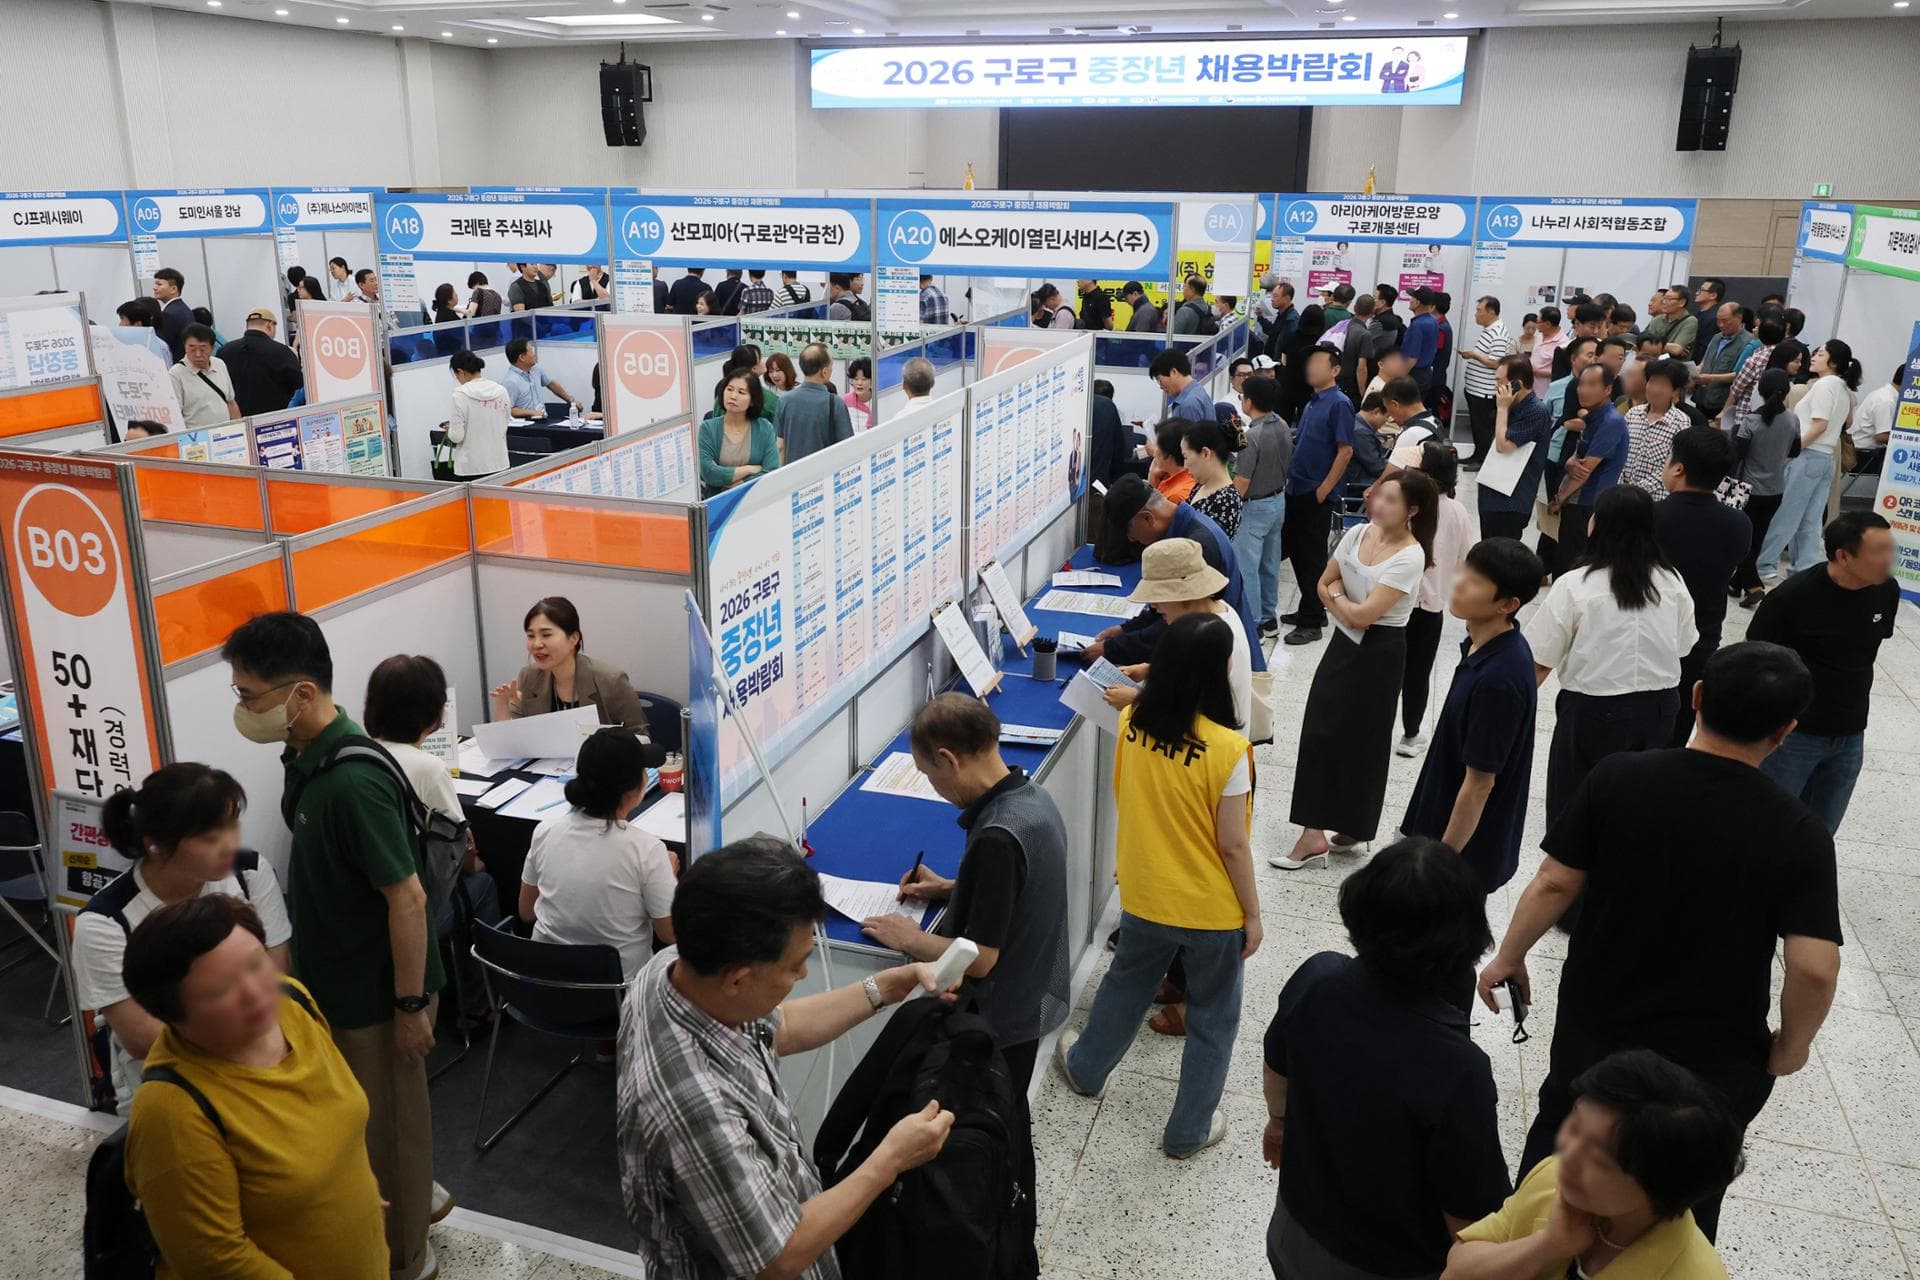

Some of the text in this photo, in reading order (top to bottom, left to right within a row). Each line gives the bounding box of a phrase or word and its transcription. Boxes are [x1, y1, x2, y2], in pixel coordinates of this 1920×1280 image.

[882, 60, 974, 86] 2026
[984, 57, 1078, 86] 구로구
[1088, 54, 1186, 85] 중장년
[1196, 51, 1374, 84] 채용박람회
[179, 204, 241, 220] 도미인서울 강남
[280, 203, 298, 215] A06
[971, 200, 991, 210] 2026
[992, 200, 1013, 210] 구로구
[1330, 203, 1441, 220] 아리아케어방문요양
[13, 209, 83, 226] CJ프레시웨이
[137, 208, 160, 221] A05
[1289, 211, 1314, 224] A12
[1491, 214, 1520, 229] A13
[1531, 215, 1668, 232] 나누리 사회적협동조합
[391, 216, 420, 235] A18
[450, 218, 553, 239] 크레탐 주식회사
[628, 221, 660, 240] A19
[670, 221, 845, 247] 산모피아(구로관악금천)
[1347, 221, 1420, 236] 구로개봉센터
[892, 226, 933, 246] A20
[939, 227, 1151, 253] 에스오케이열린서비스(주)
[26, 526, 107, 576] B03
[719, 588, 751, 626] 2026
[752, 570, 781, 606] 구로구
[720, 598, 783, 679] 중장년
